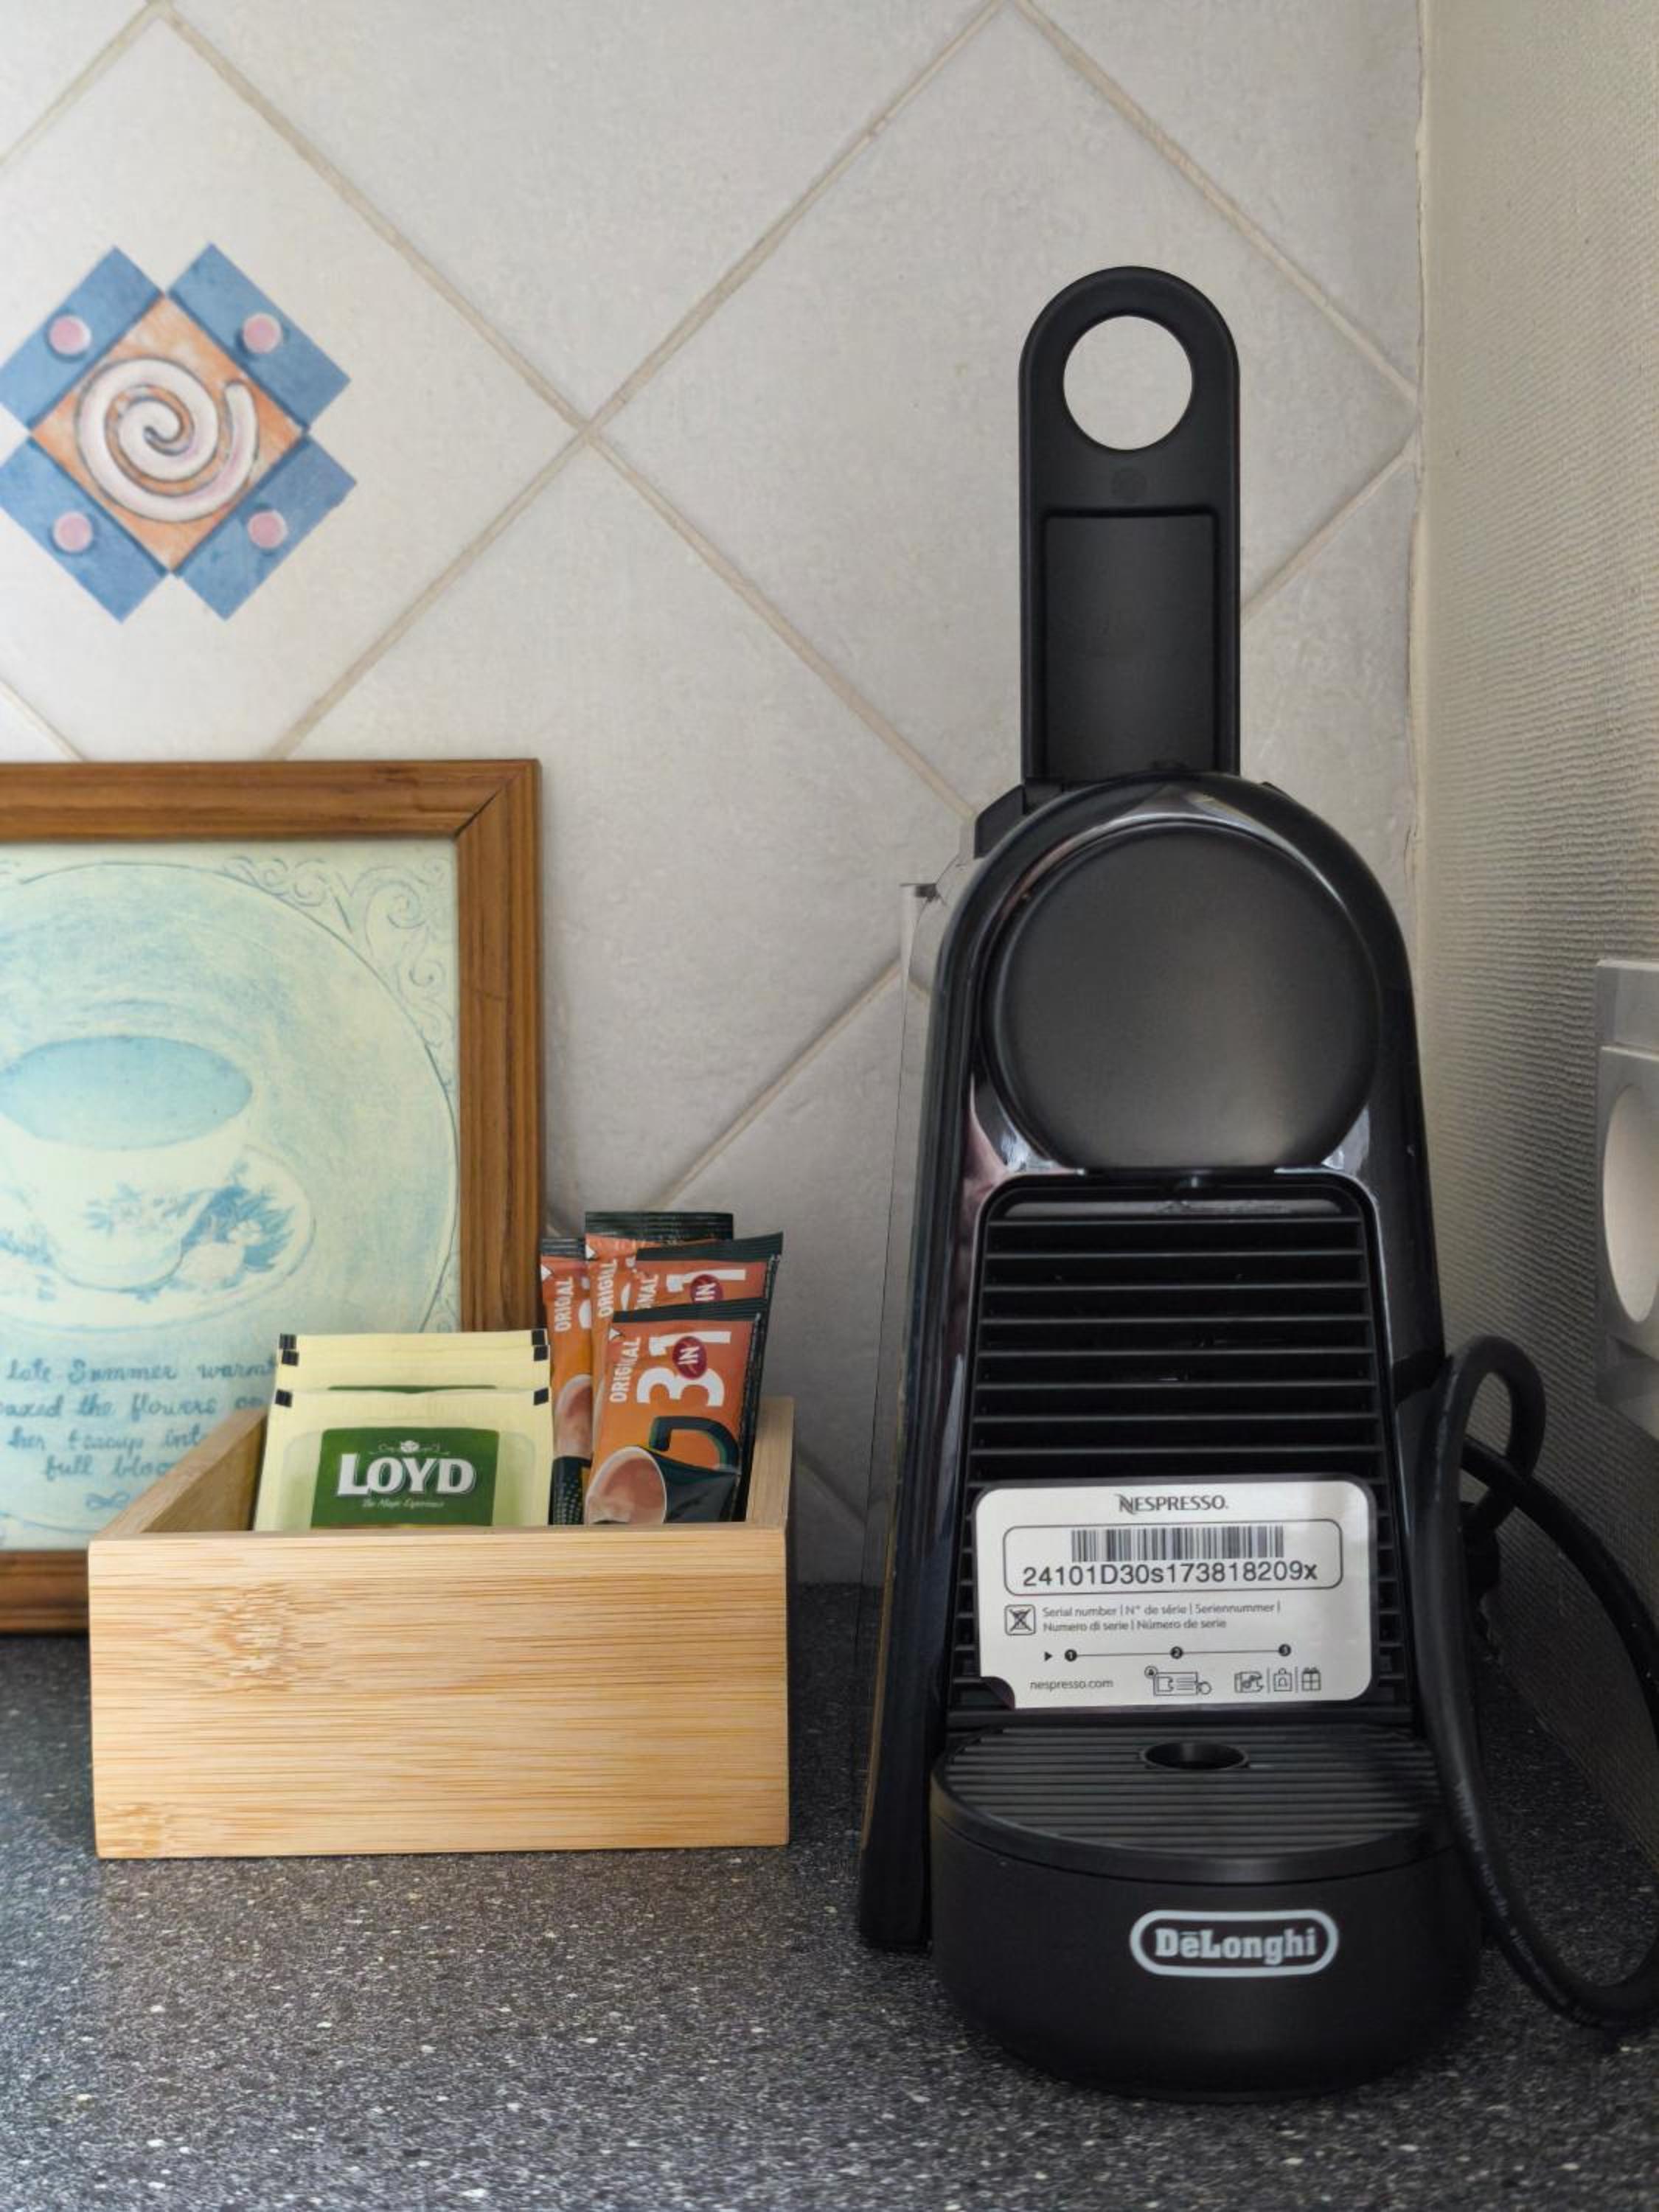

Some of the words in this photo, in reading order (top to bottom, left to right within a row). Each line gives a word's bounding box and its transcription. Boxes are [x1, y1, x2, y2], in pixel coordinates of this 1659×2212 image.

[694, 1282, 717, 1301] IN
[648, 1331, 731, 1357] 1
[678, 1346, 700, 1365] IN
[67, 1358, 177, 1384] Summer
[196, 1358, 275, 1380] warmt
[609, 1337, 641, 1404] ORIGINAL
[637, 1368, 725, 1407] 3
[77, 1394, 115, 1416] the
[131, 1393, 218, 1422] flowers
[162, 1424, 204, 1447] int
[44, 1455, 94, 1481] full
[112, 1455, 175, 1478] bloo
[337, 1453, 476, 1497] LOYD
[1118, 1495, 1228, 1514] NESPRESSO
[1022, 1560, 1318, 1587] 24101D30s173818209x
[1042, 1607, 1073, 1617] Serial
[1074, 1606, 1117, 1616] number
[1144, 1604, 1158, 1615] de
[1194, 1602, 1275, 1614] Seriennummer
[1103, 1621, 1129, 1631] serie
[1183, 1618, 1197, 1629] de
[1200, 1618, 1227, 1629] serie
[1030, 1678, 1113, 1691] nespresso.com
